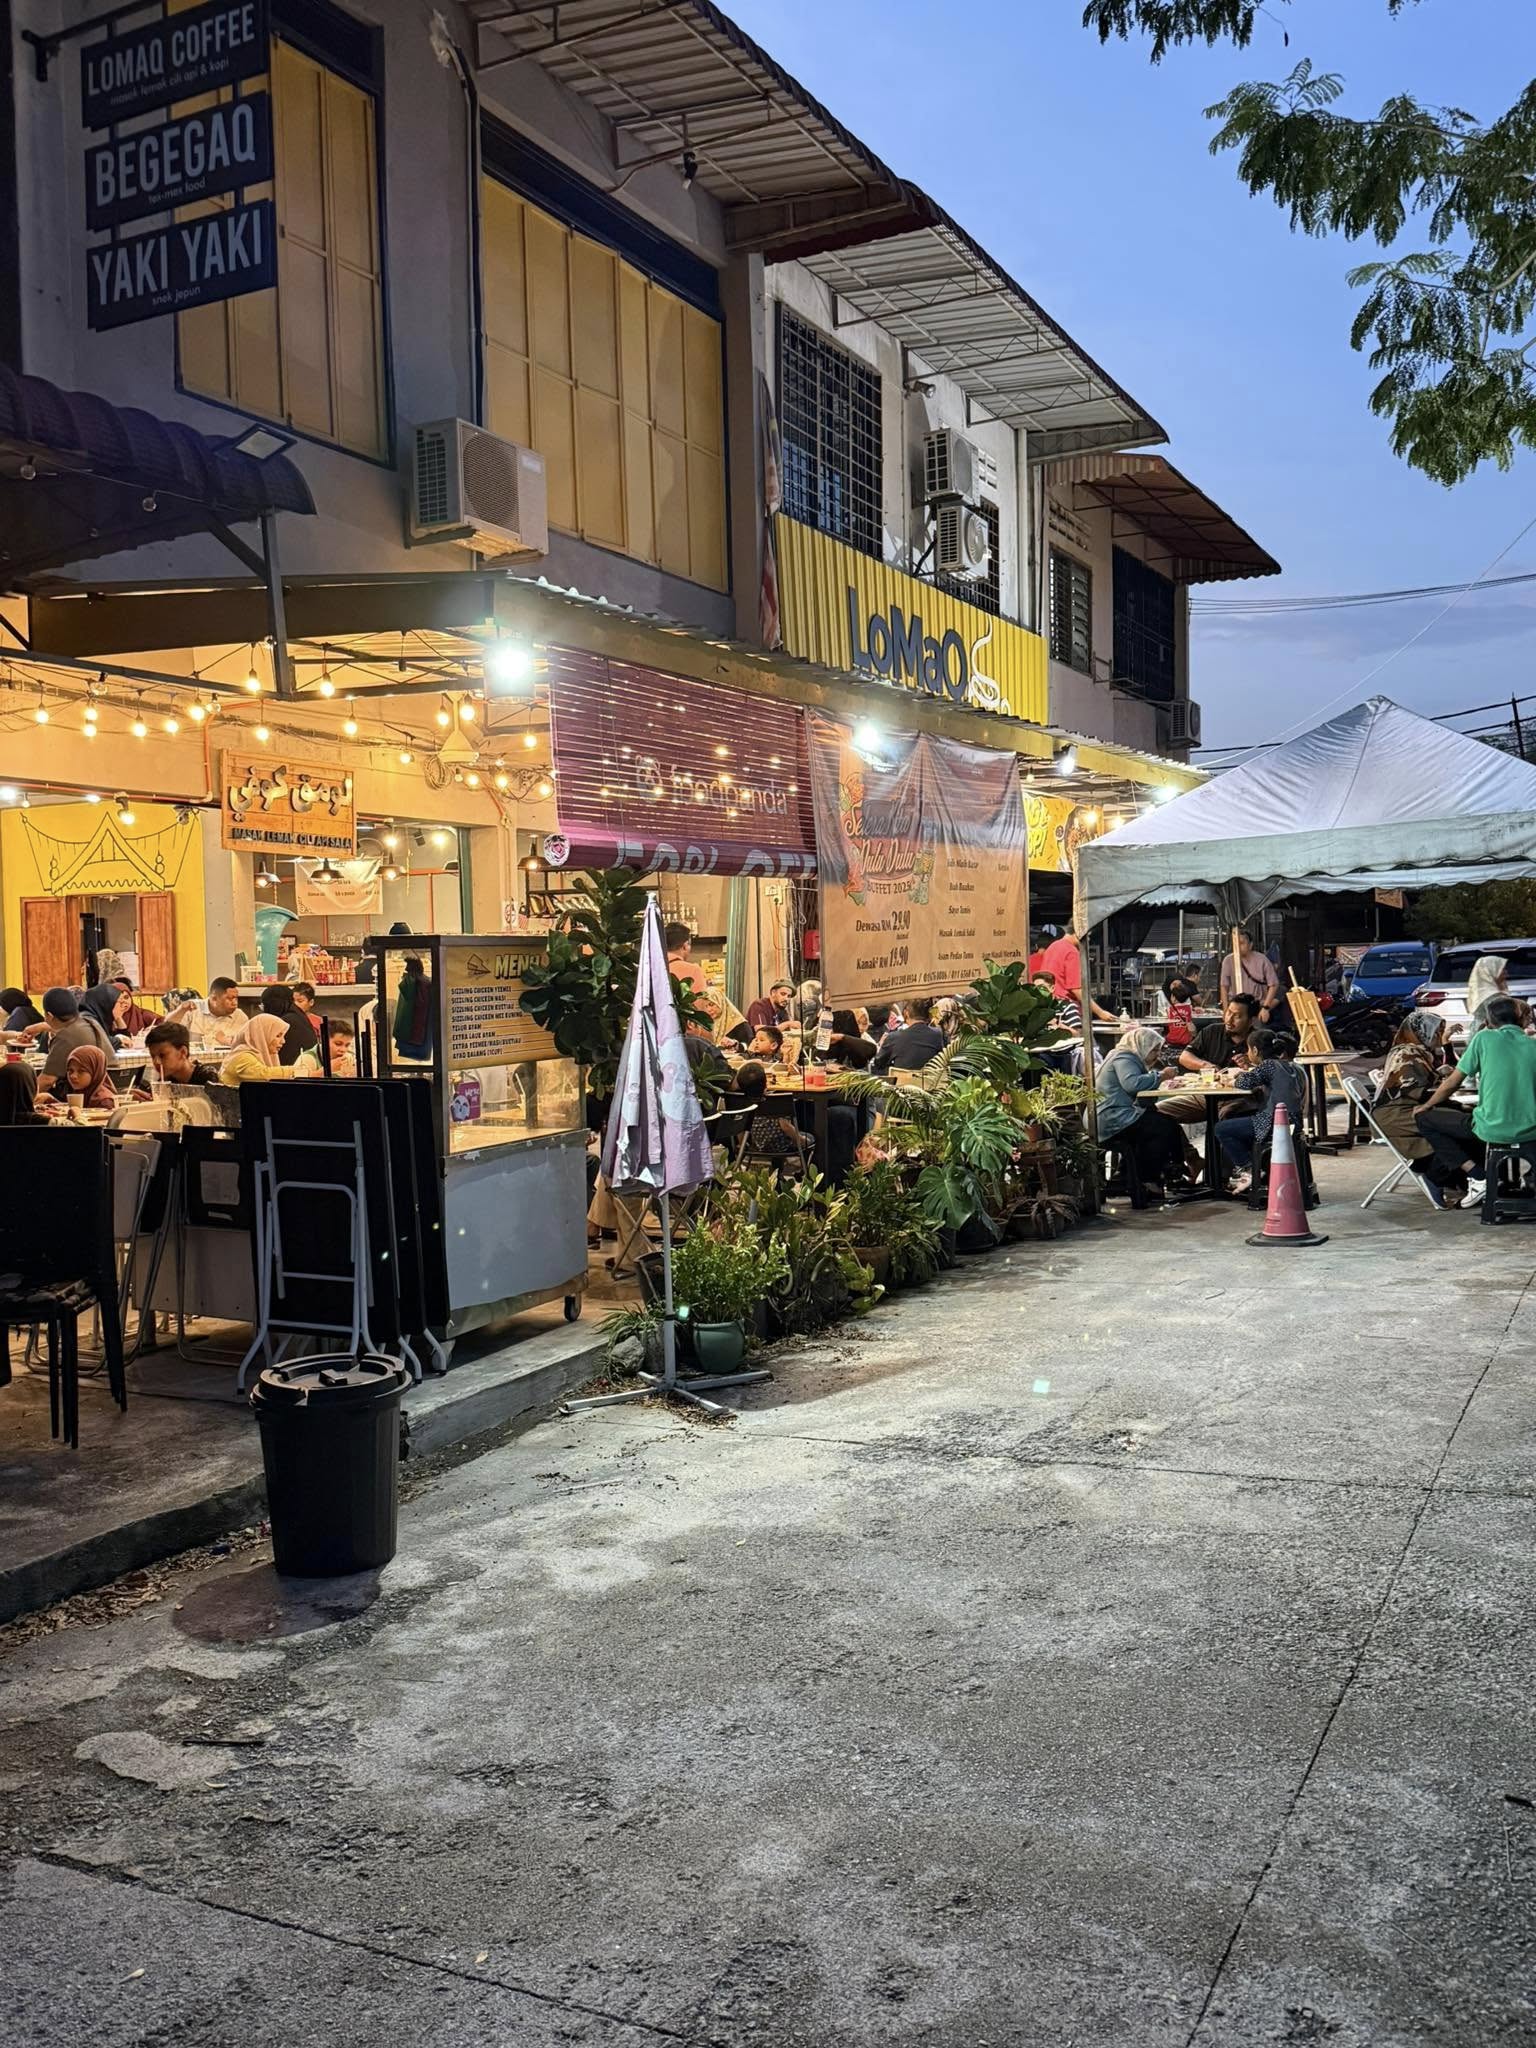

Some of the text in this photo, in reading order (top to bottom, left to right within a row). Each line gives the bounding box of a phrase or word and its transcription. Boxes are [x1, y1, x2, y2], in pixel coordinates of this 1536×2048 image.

[88, 3, 255, 97] LOMAQ COFFEE
[140, 83, 166, 98] lemak
[184, 69, 198, 83] api
[200, 64, 208, 75] &
[209, 56, 230, 73] kopi
[96, 103, 256, 207] BEGEGAQ
[185, 177, 206, 192] food
[92, 209, 262, 306] YAKI YAKI
[175, 286, 201, 303] jepun
[671, 763, 788, 820] foodpanda
[856, 919, 880, 932] Dewasa
[452, 1033, 468, 1041] EXTRA
[452, 1042, 468, 1050] EXTRA
